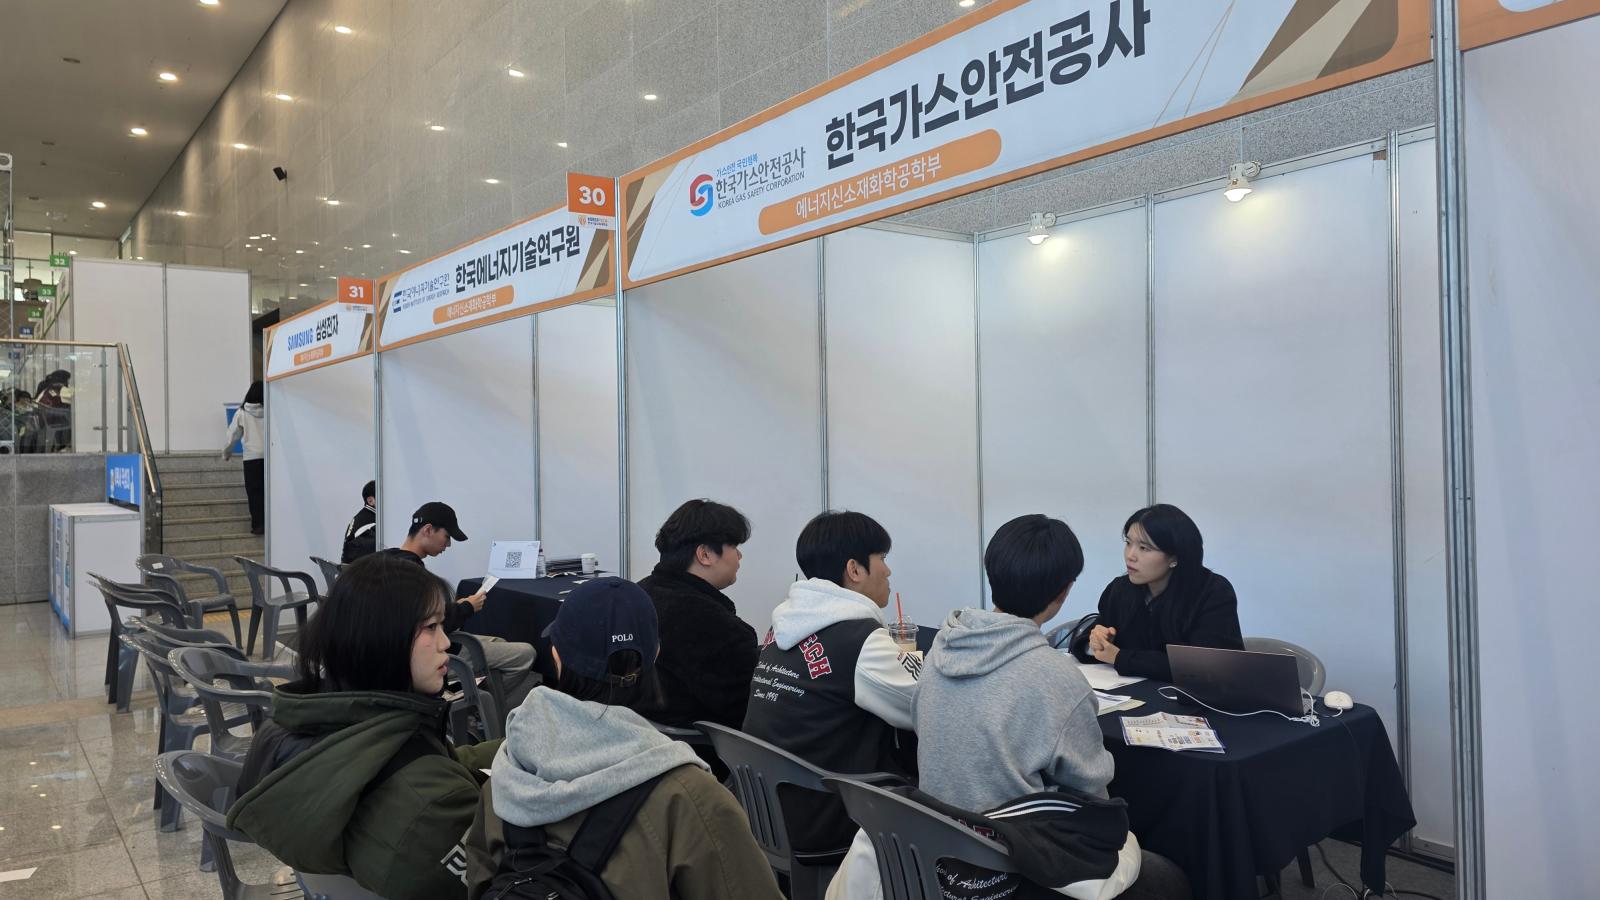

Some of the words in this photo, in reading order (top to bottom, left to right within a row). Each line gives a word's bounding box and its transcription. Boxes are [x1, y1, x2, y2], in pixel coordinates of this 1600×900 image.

[825, 0, 1152, 170] 한국가스안전공사
[715, 146, 806, 200] 한국가스안전공사
[765, 171, 805, 192] CORPORATION
[795, 152, 942, 219] 에너지신소재화학공학부
[578, 185, 606, 206] 30
[455, 225, 580, 294] 한국에너지기술연구원
[348, 285, 365, 299] 31
[287, 328, 314, 352] SAMSUNG
[316, 313, 339, 342] 삼성전자
[611, 633, 634, 643] POLO
